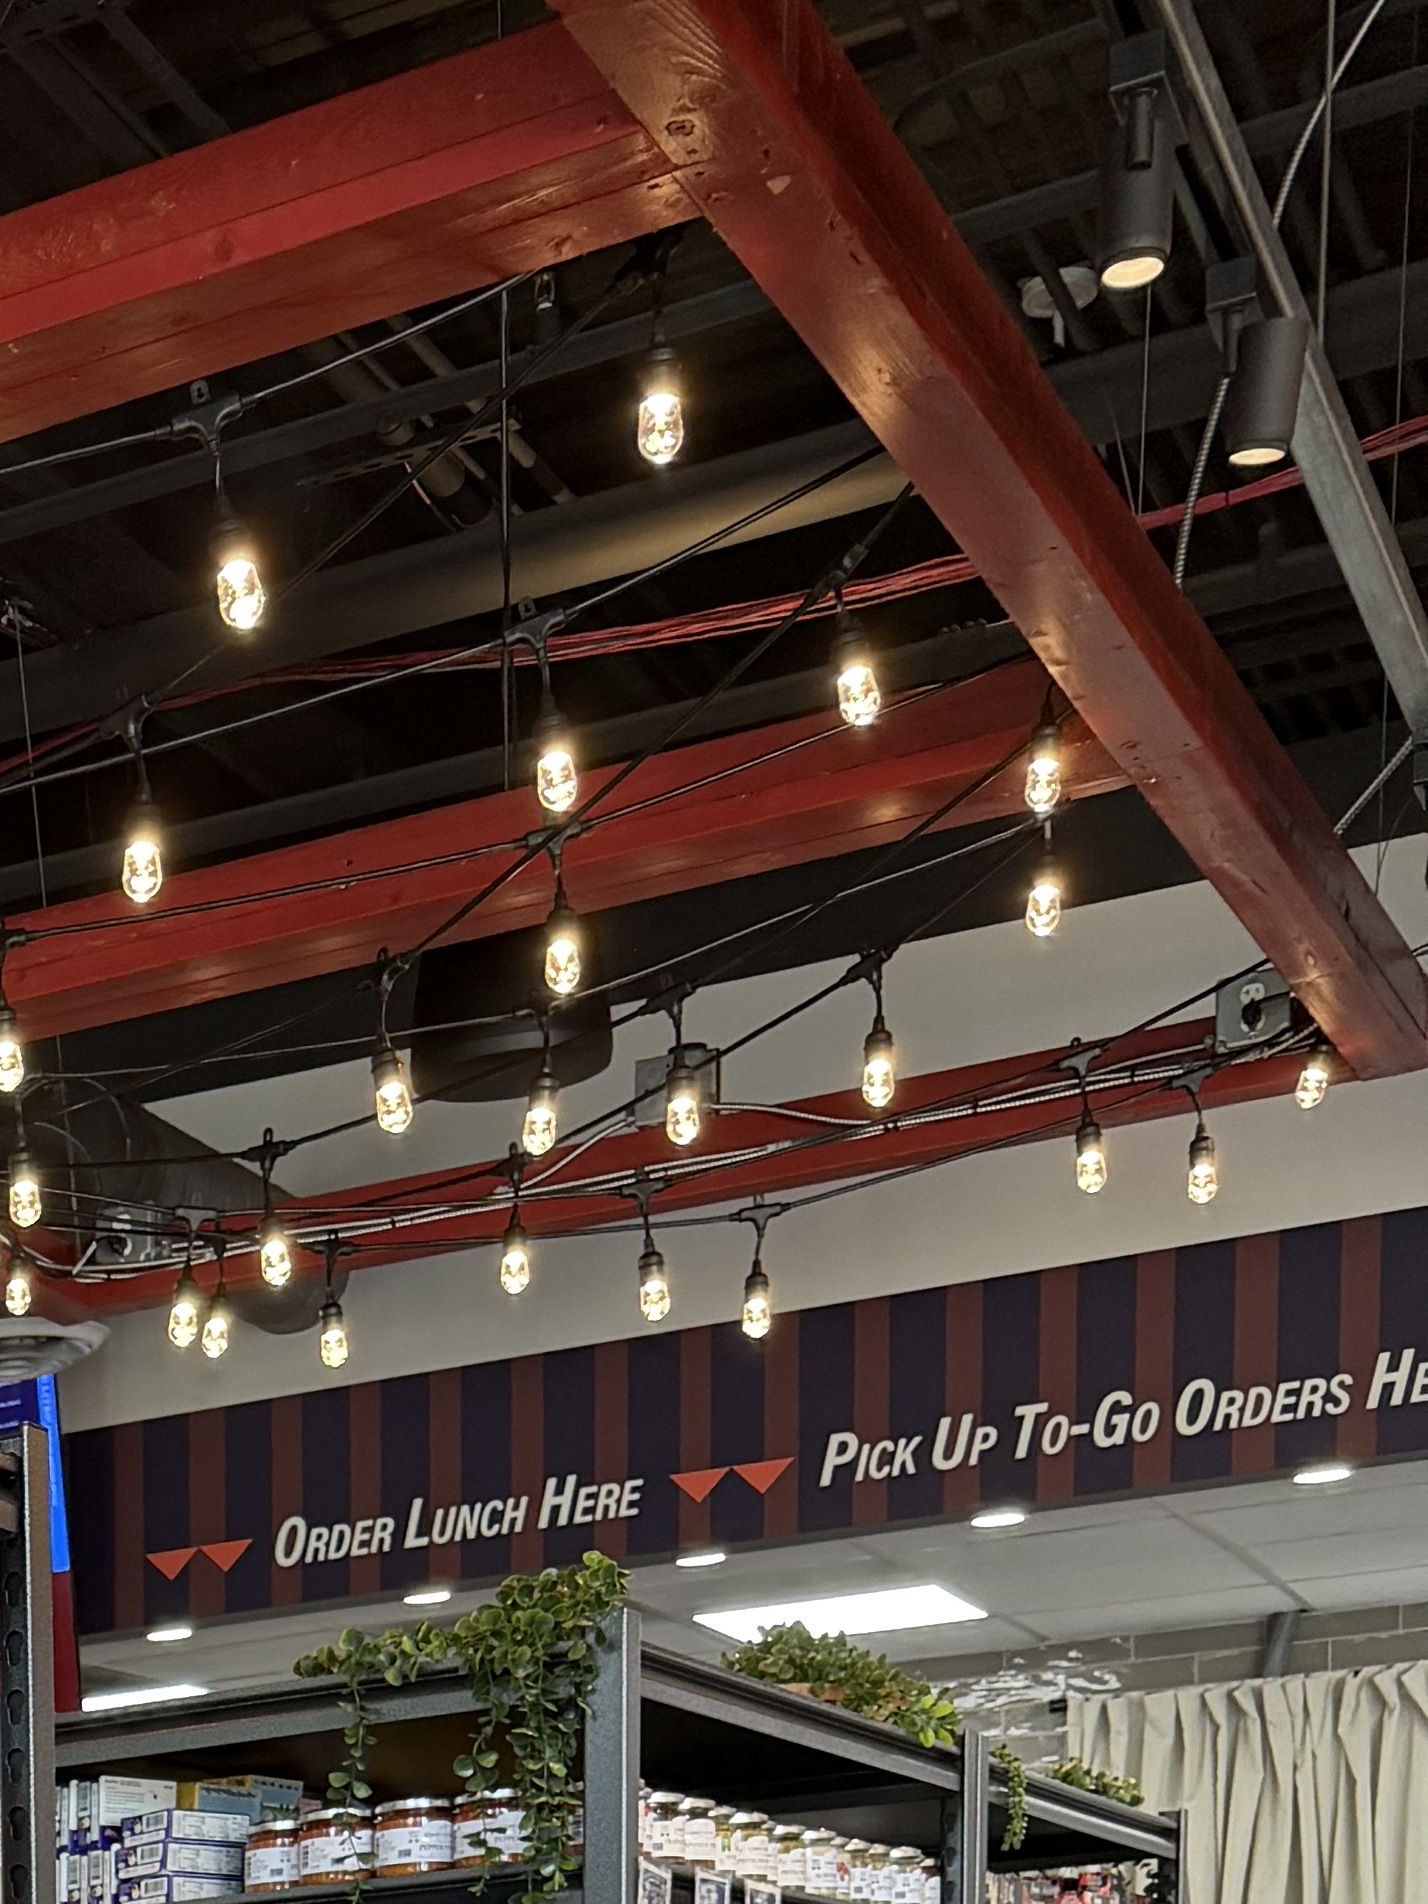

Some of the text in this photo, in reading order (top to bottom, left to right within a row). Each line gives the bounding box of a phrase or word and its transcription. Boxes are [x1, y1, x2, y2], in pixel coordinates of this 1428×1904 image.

[818, 1431, 922, 1488] PICK
[931, 1412, 999, 1471] UP
[1175, 1373, 1354, 1437] ORDERS
[275, 1473, 644, 1568] ORDER LUNCH HERE
